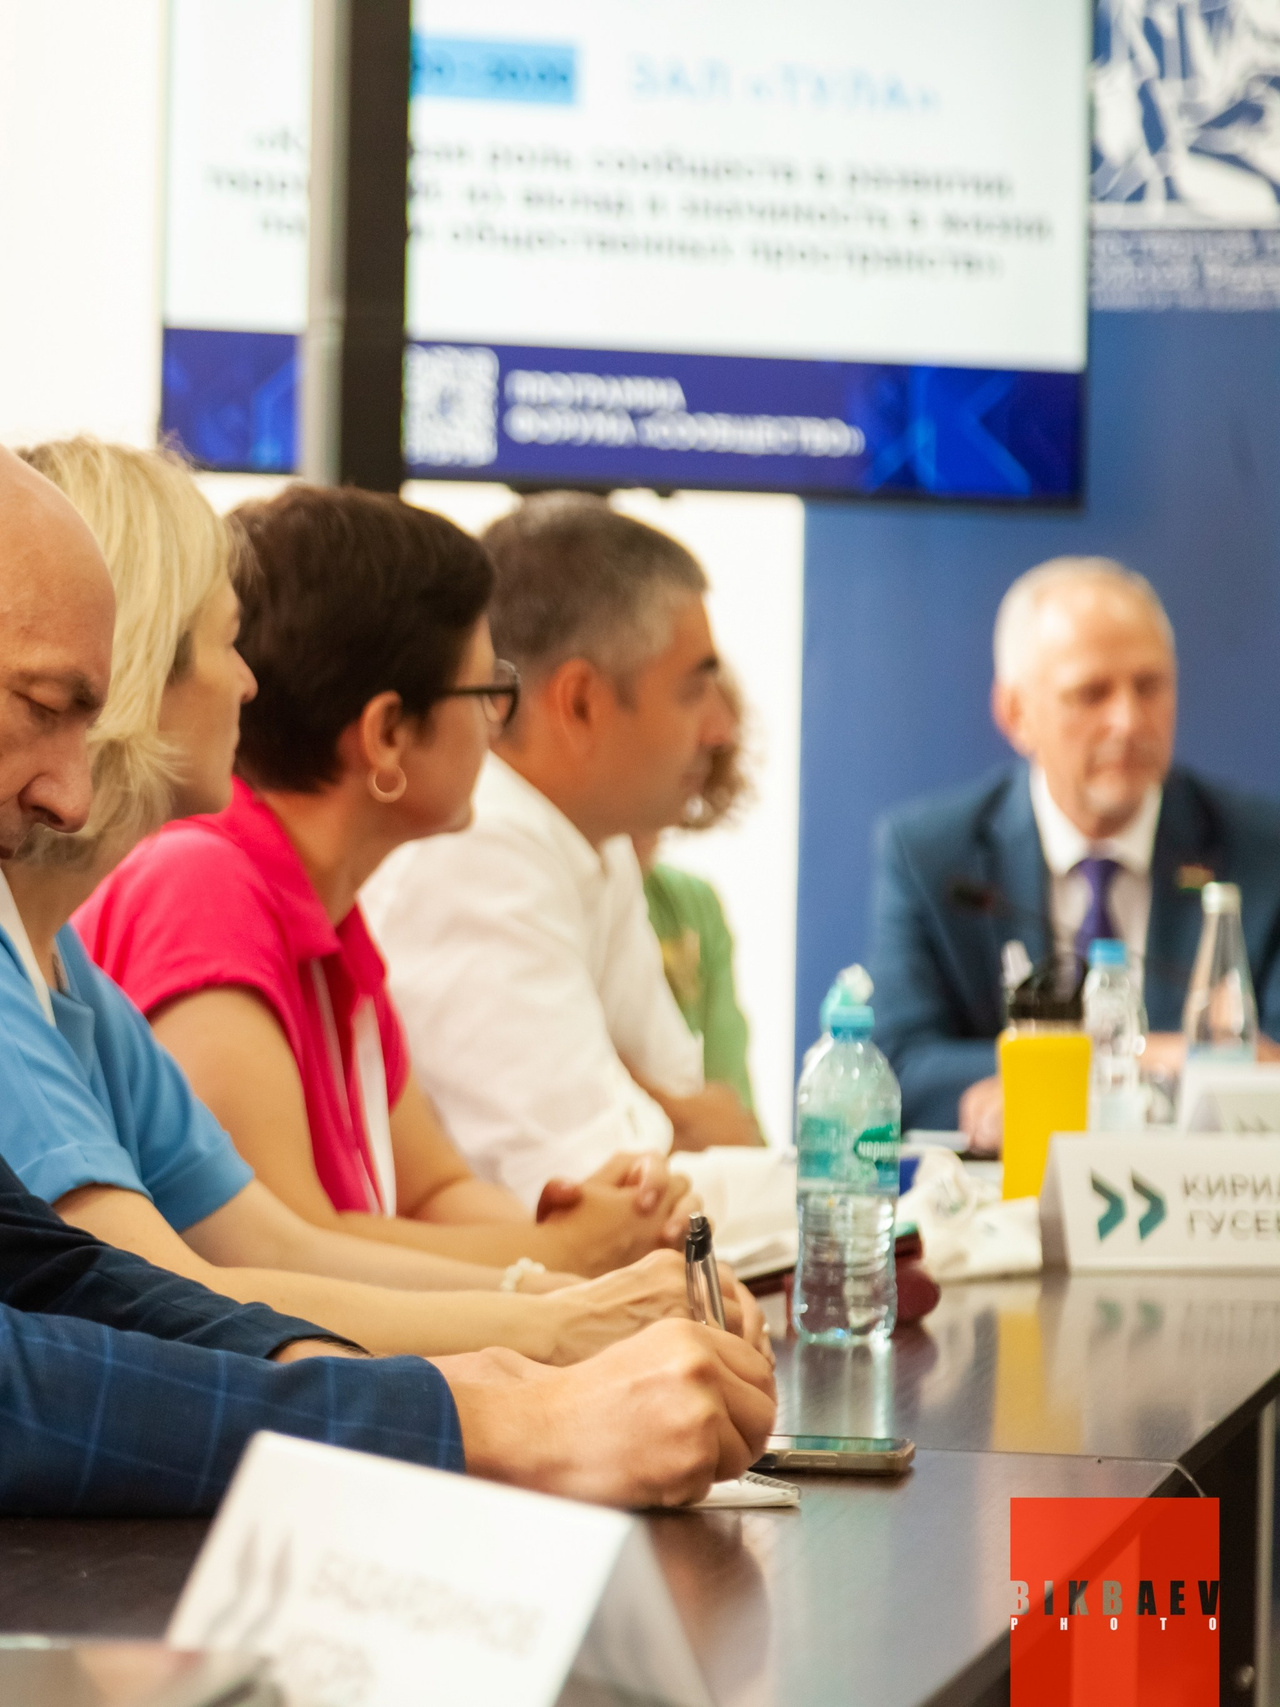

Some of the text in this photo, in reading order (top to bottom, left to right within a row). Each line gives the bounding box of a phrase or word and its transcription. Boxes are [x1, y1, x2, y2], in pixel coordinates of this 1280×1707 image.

[626, 54, 730, 103] ЗАЛ
[485, 142, 575, 175] роль
[592, 148, 801, 189] сообществ
[842, 166, 1016, 202] развитии
[1181, 1172, 1280, 1201] КИРИ
[1186, 1209, 1280, 1241] ГУСЕ
